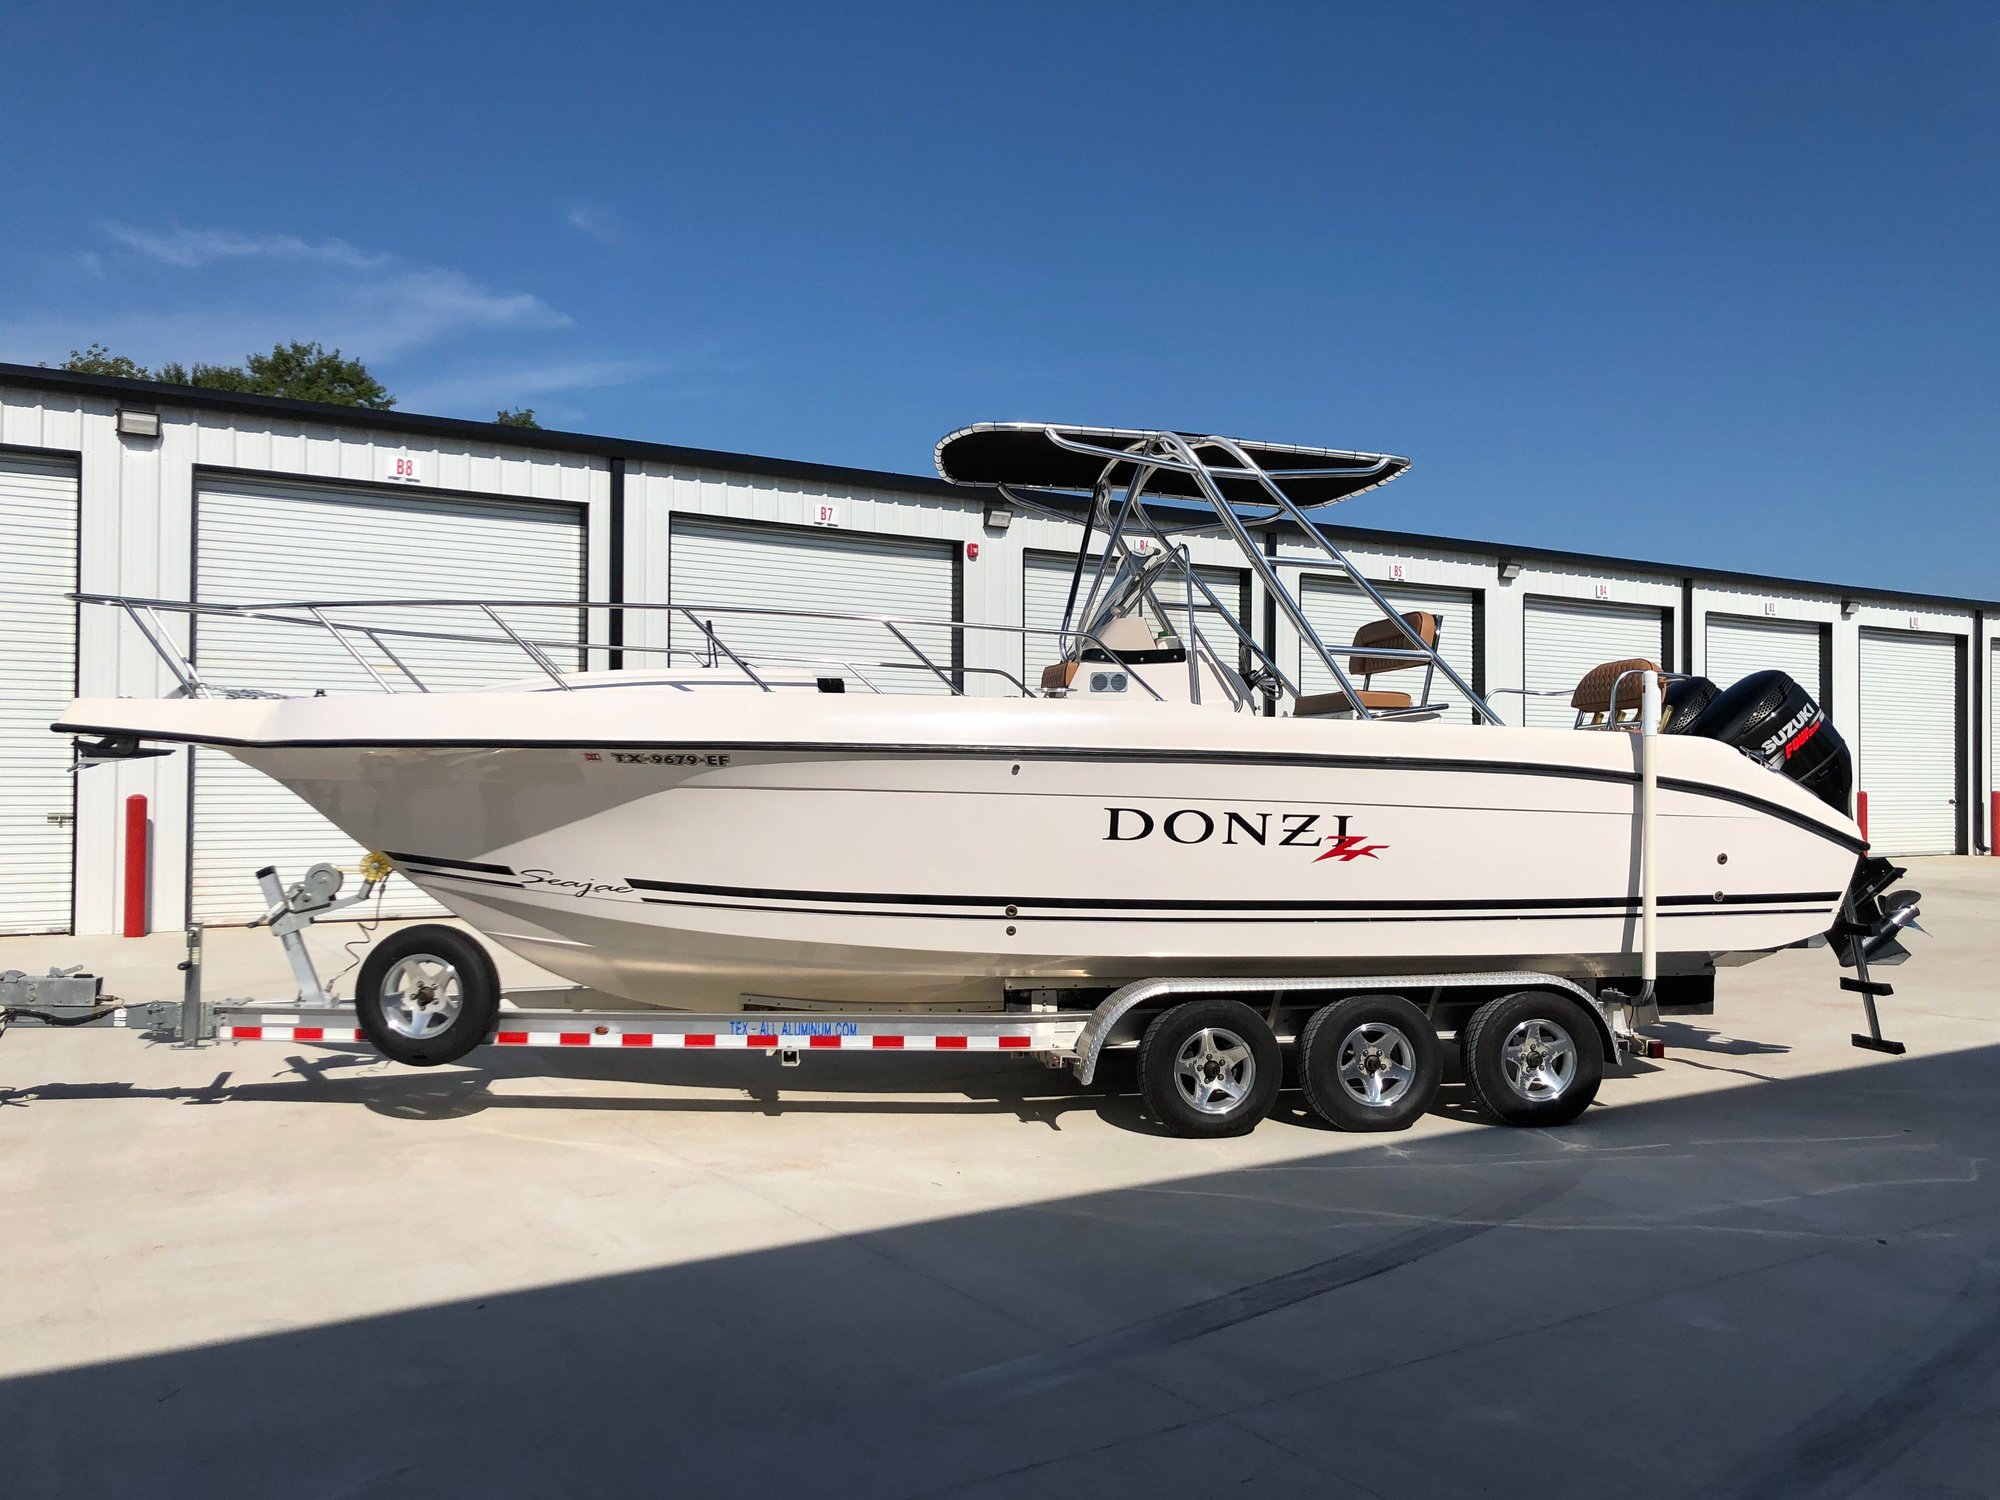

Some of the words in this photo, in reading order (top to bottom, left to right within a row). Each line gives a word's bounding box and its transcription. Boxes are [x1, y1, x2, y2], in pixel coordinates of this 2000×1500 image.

[396, 458, 413, 476] B8
[820, 506, 833, 521] B7
[1394, 565, 1402, 577] B5
[1600, 584, 1607, 596] B4
[1761, 702, 1815, 755] SUZUKI
[610, 753, 730, 766] TX-9679-EF
[1101, 807, 1353, 848] DONZI
